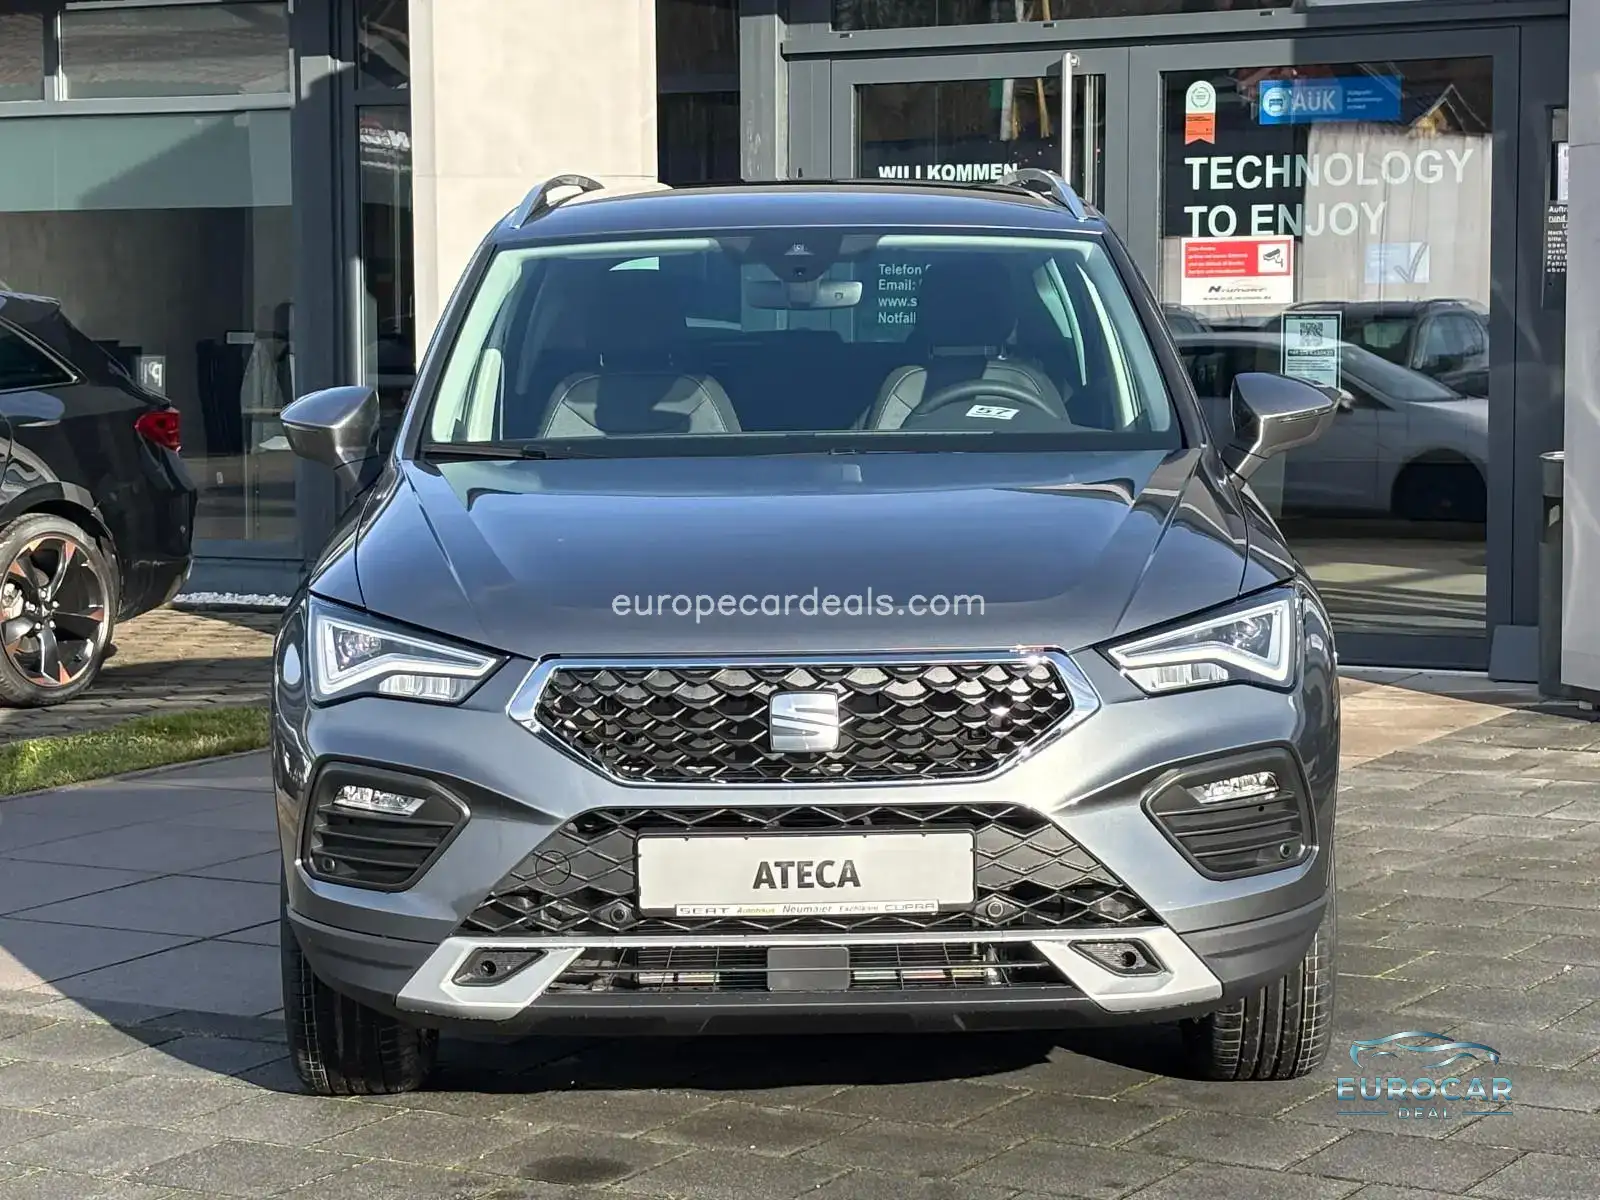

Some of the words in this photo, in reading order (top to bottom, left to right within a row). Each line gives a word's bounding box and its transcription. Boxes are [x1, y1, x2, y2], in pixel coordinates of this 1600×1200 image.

[1184, 148, 1474, 190] TECHNOLOGY
[1183, 204, 1238, 238] TO
[1252, 200, 1388, 237] ENJOY
[878, 264, 922, 275] Telefon
[878, 278, 916, 291] Email:
[878, 311, 916, 324] Notfall
[752, 859, 862, 890] ATECA
[783, 904, 832, 913] Neumaier
[885, 903, 935, 911] CUPRA
